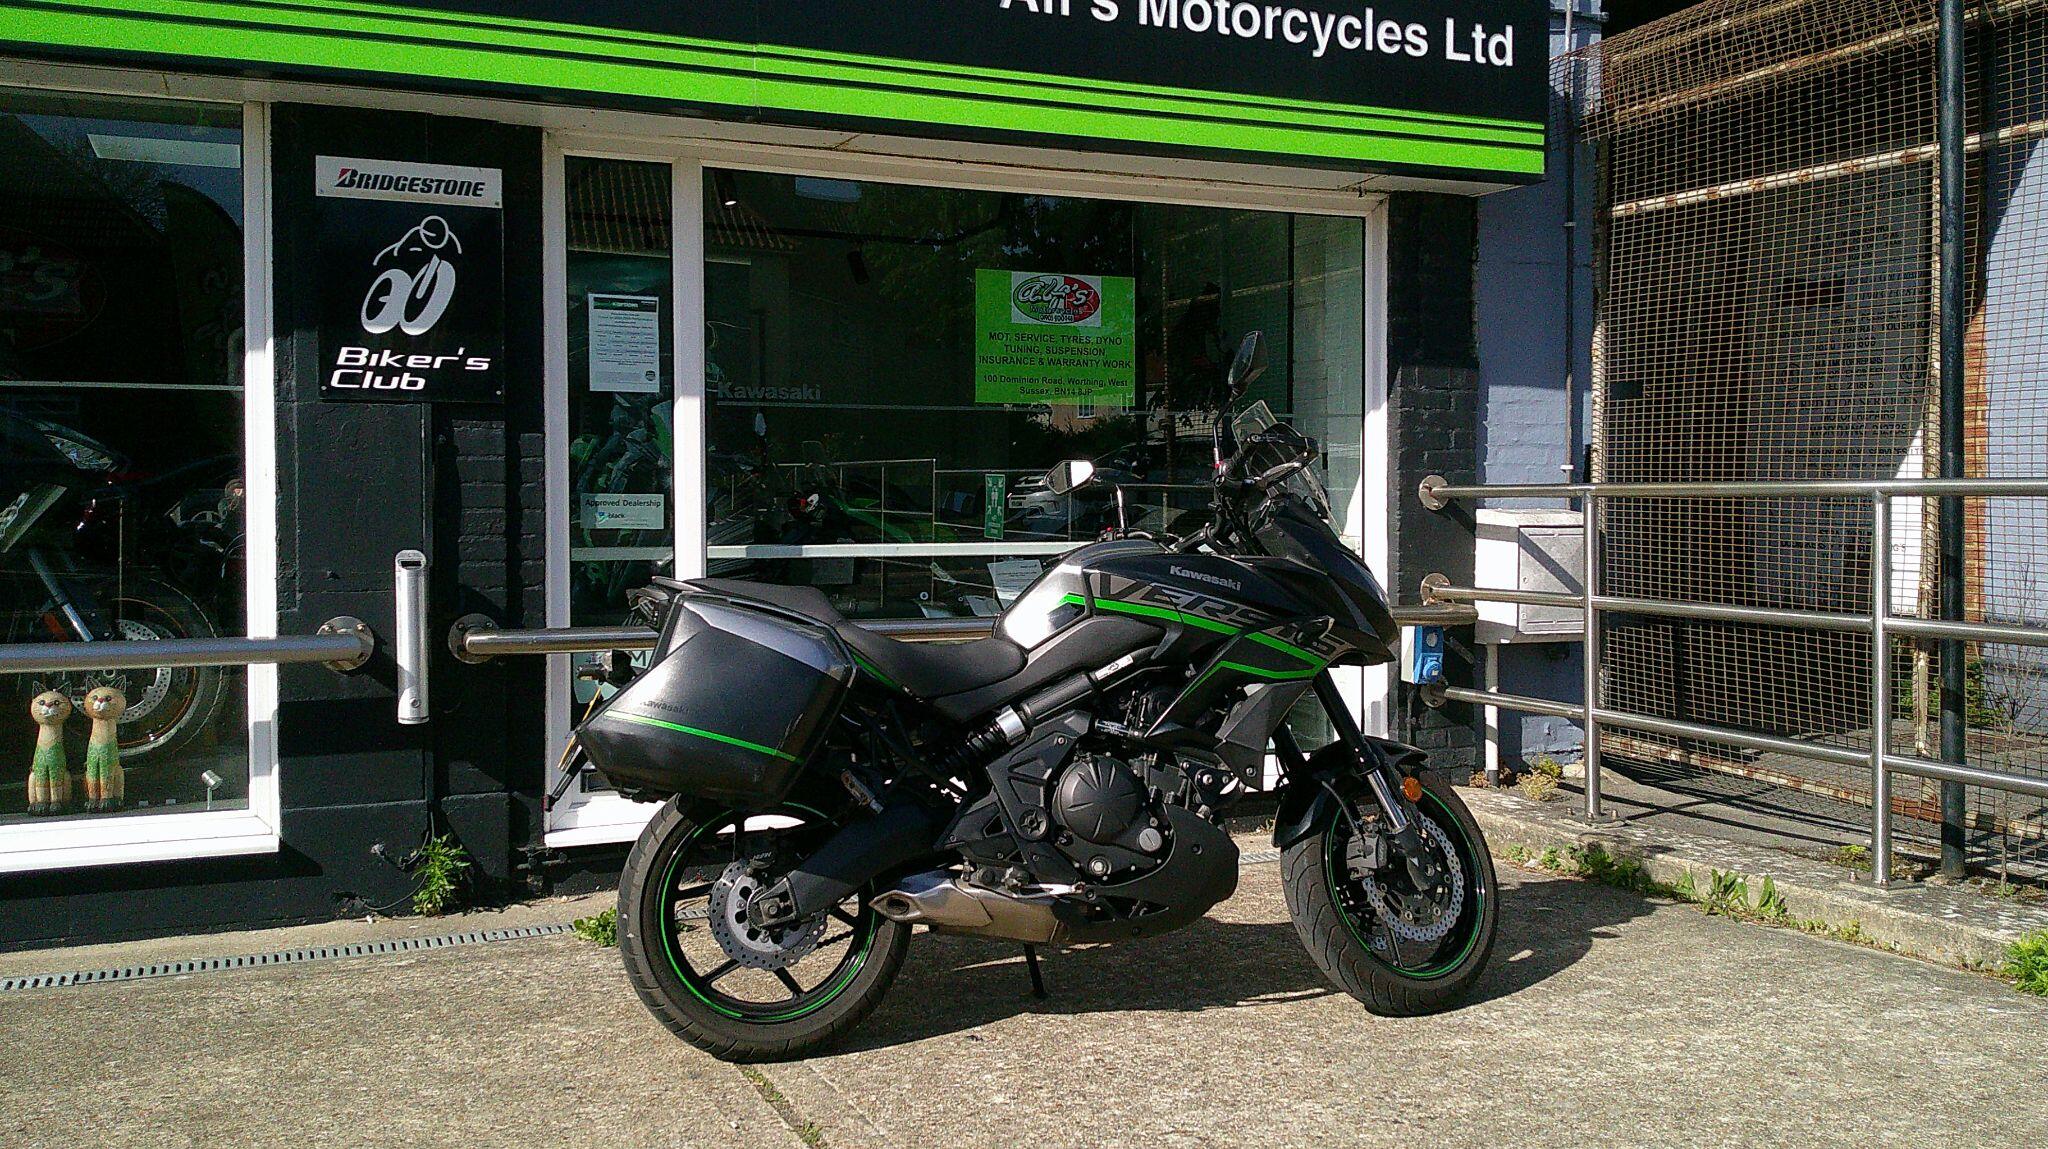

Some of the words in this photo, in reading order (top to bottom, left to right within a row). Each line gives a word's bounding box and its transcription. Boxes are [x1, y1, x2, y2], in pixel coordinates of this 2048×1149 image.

[1138, 0, 1429, 58] Motorcycles
[1444, 17, 1514, 67] Ltd
[335, 168, 486, 198] BRIDGESTONE
[1096, 337, 1122, 346] DYNO
[336, 346, 491, 370] Biker's
[979, 356, 1034, 366] INSURANCE
[1037, 358, 1044, 366] &
[1047, 357, 1101, 368] WARRANTY
[1102, 359, 1132, 369] WORK
[330, 369, 427, 391] Club
[717, 381, 823, 401] Kawasaki
[1000, 375, 1039, 384] Dominion
[1108, 378, 1128, 388] West
[585, 498, 621, 508] Approved
[623, 499, 662, 509] Dealership
[1169, 564, 1243, 592] Kawasaki
[1097, 568, 1356, 661] VERSS
